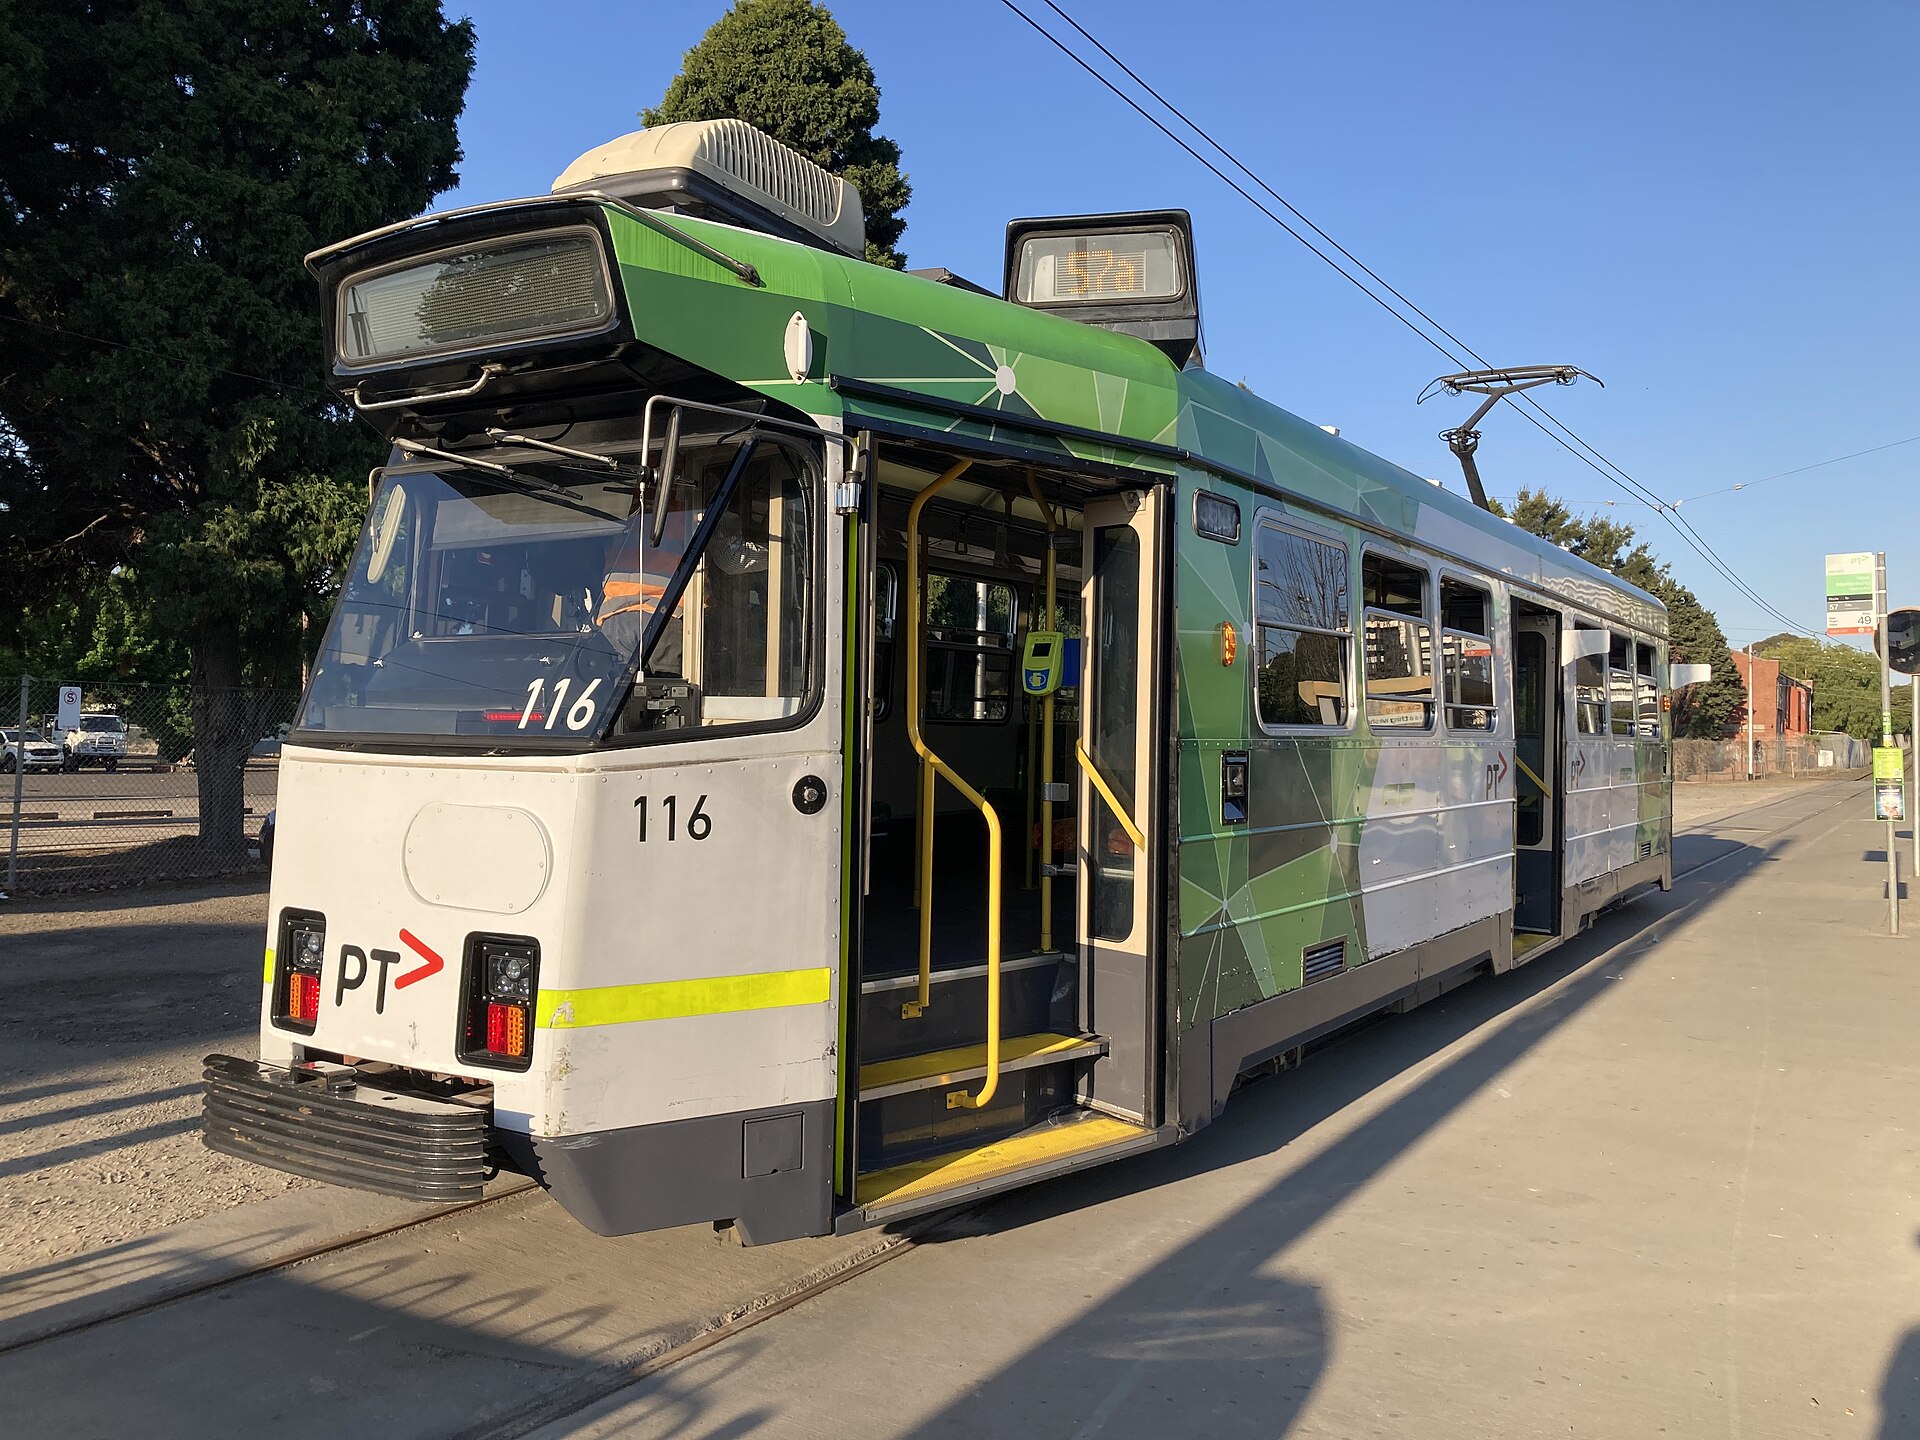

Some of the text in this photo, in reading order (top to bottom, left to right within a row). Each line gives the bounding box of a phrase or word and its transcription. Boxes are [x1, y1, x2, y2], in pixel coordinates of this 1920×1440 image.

[1068, 249, 1135, 295] 57a
[1857, 615, 1872, 625] 49
[517, 678, 602, 731] 116
[1486, 764, 1500, 800] PT
[633, 794, 713, 842] 116
[335, 944, 401, 1015] PT
